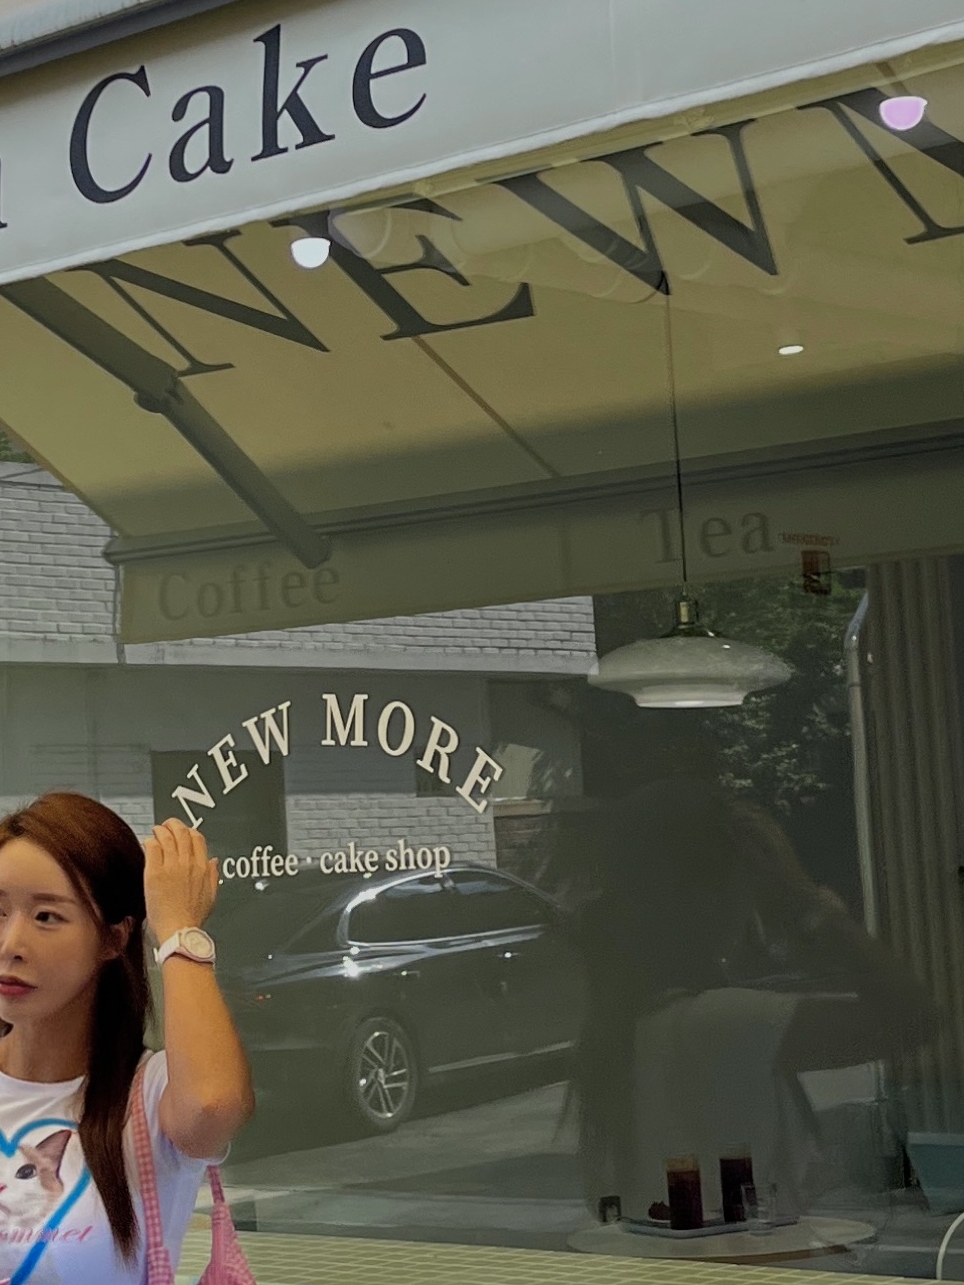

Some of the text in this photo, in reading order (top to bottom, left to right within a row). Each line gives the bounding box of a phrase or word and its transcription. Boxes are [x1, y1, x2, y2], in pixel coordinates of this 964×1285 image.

[69, 23, 427, 205] Cake
[638, 507, 775, 564] Tea
[158, 560, 341, 621] Coffee
[171, 693, 503, 829] NEW MORE
[223, 839, 451, 879] coffee cake shop
